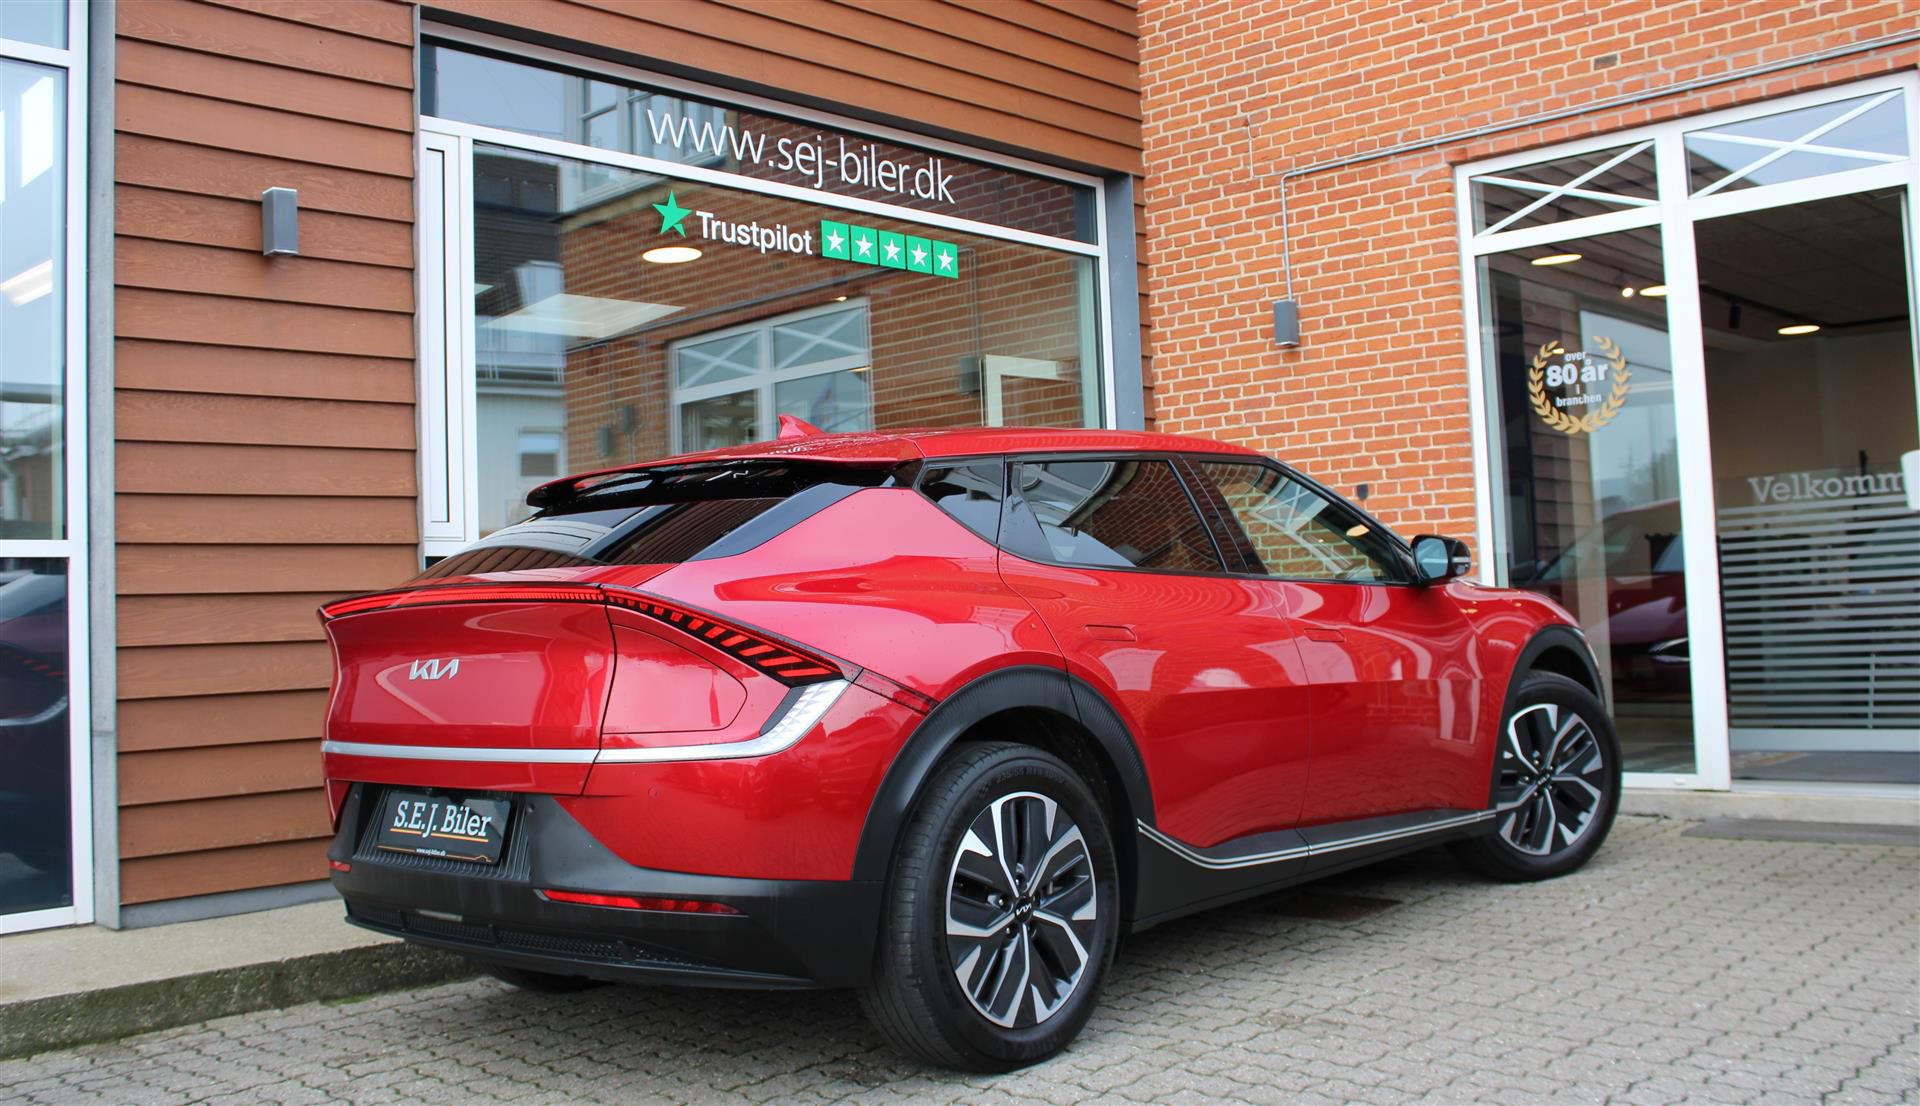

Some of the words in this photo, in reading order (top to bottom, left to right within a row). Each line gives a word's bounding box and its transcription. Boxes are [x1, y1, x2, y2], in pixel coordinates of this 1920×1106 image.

[647, 109, 956, 204] www.sej-biler.dk
[695, 210, 813, 256] Trustpilot
[1565, 351, 1587, 361] over
[1546, 364, 1577, 387] 80
[1581, 359, 1608, 382] år
[1556, 393, 1601, 406] branchen
[408, 658, 460, 681] KIA
[393, 799, 438, 839] S.E.J.
[440, 804, 492, 837] Biler
